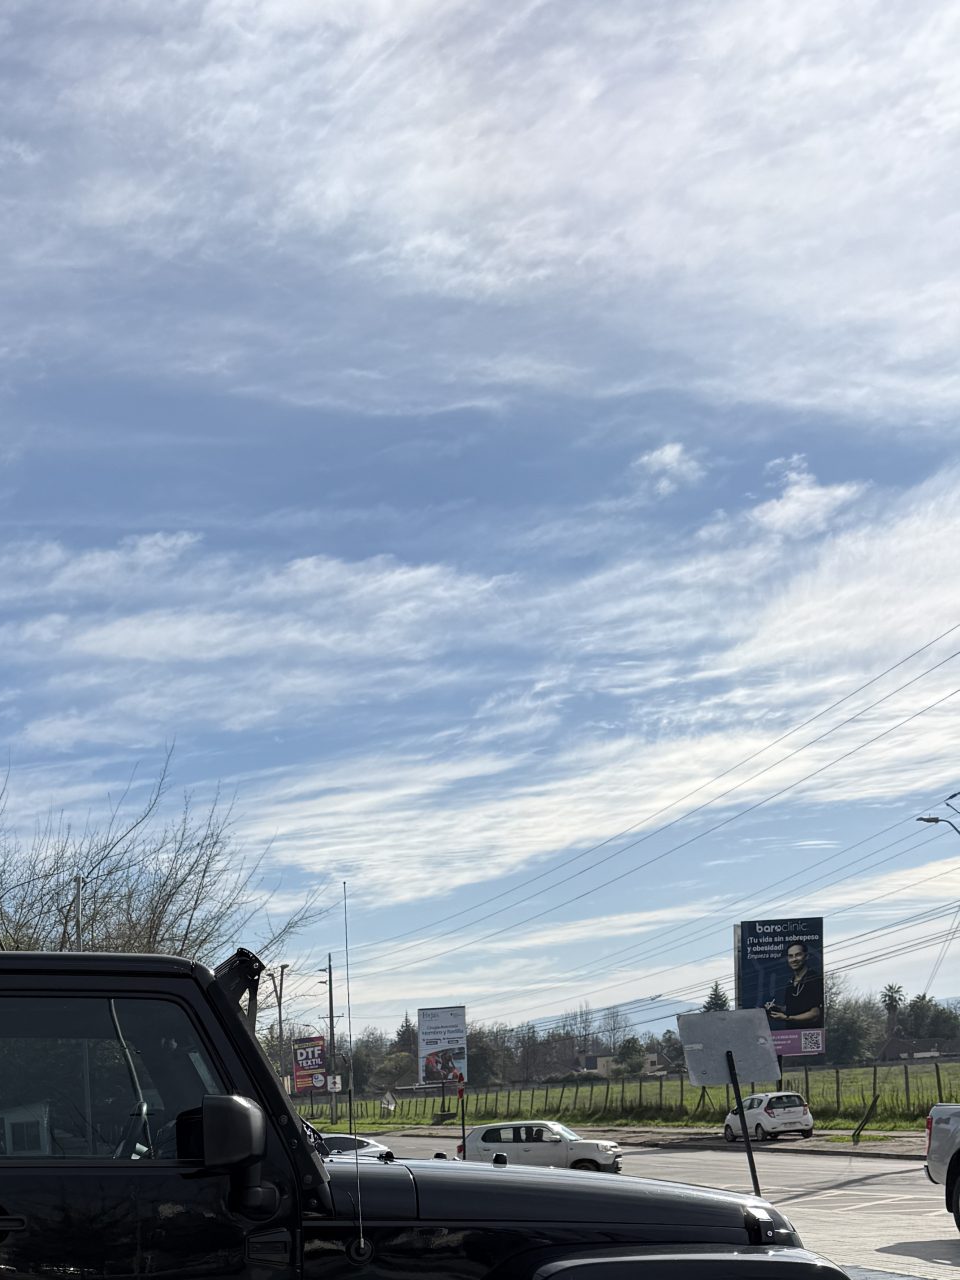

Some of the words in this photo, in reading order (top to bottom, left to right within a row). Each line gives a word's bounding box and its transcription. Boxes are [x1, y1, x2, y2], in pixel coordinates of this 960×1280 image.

[785, 934, 819, 942] sobrepeso
[752, 944, 784, 952] obesidad!
[296, 1046, 322, 1061] DTF
[298, 1058, 323, 1067] TEXTIL
